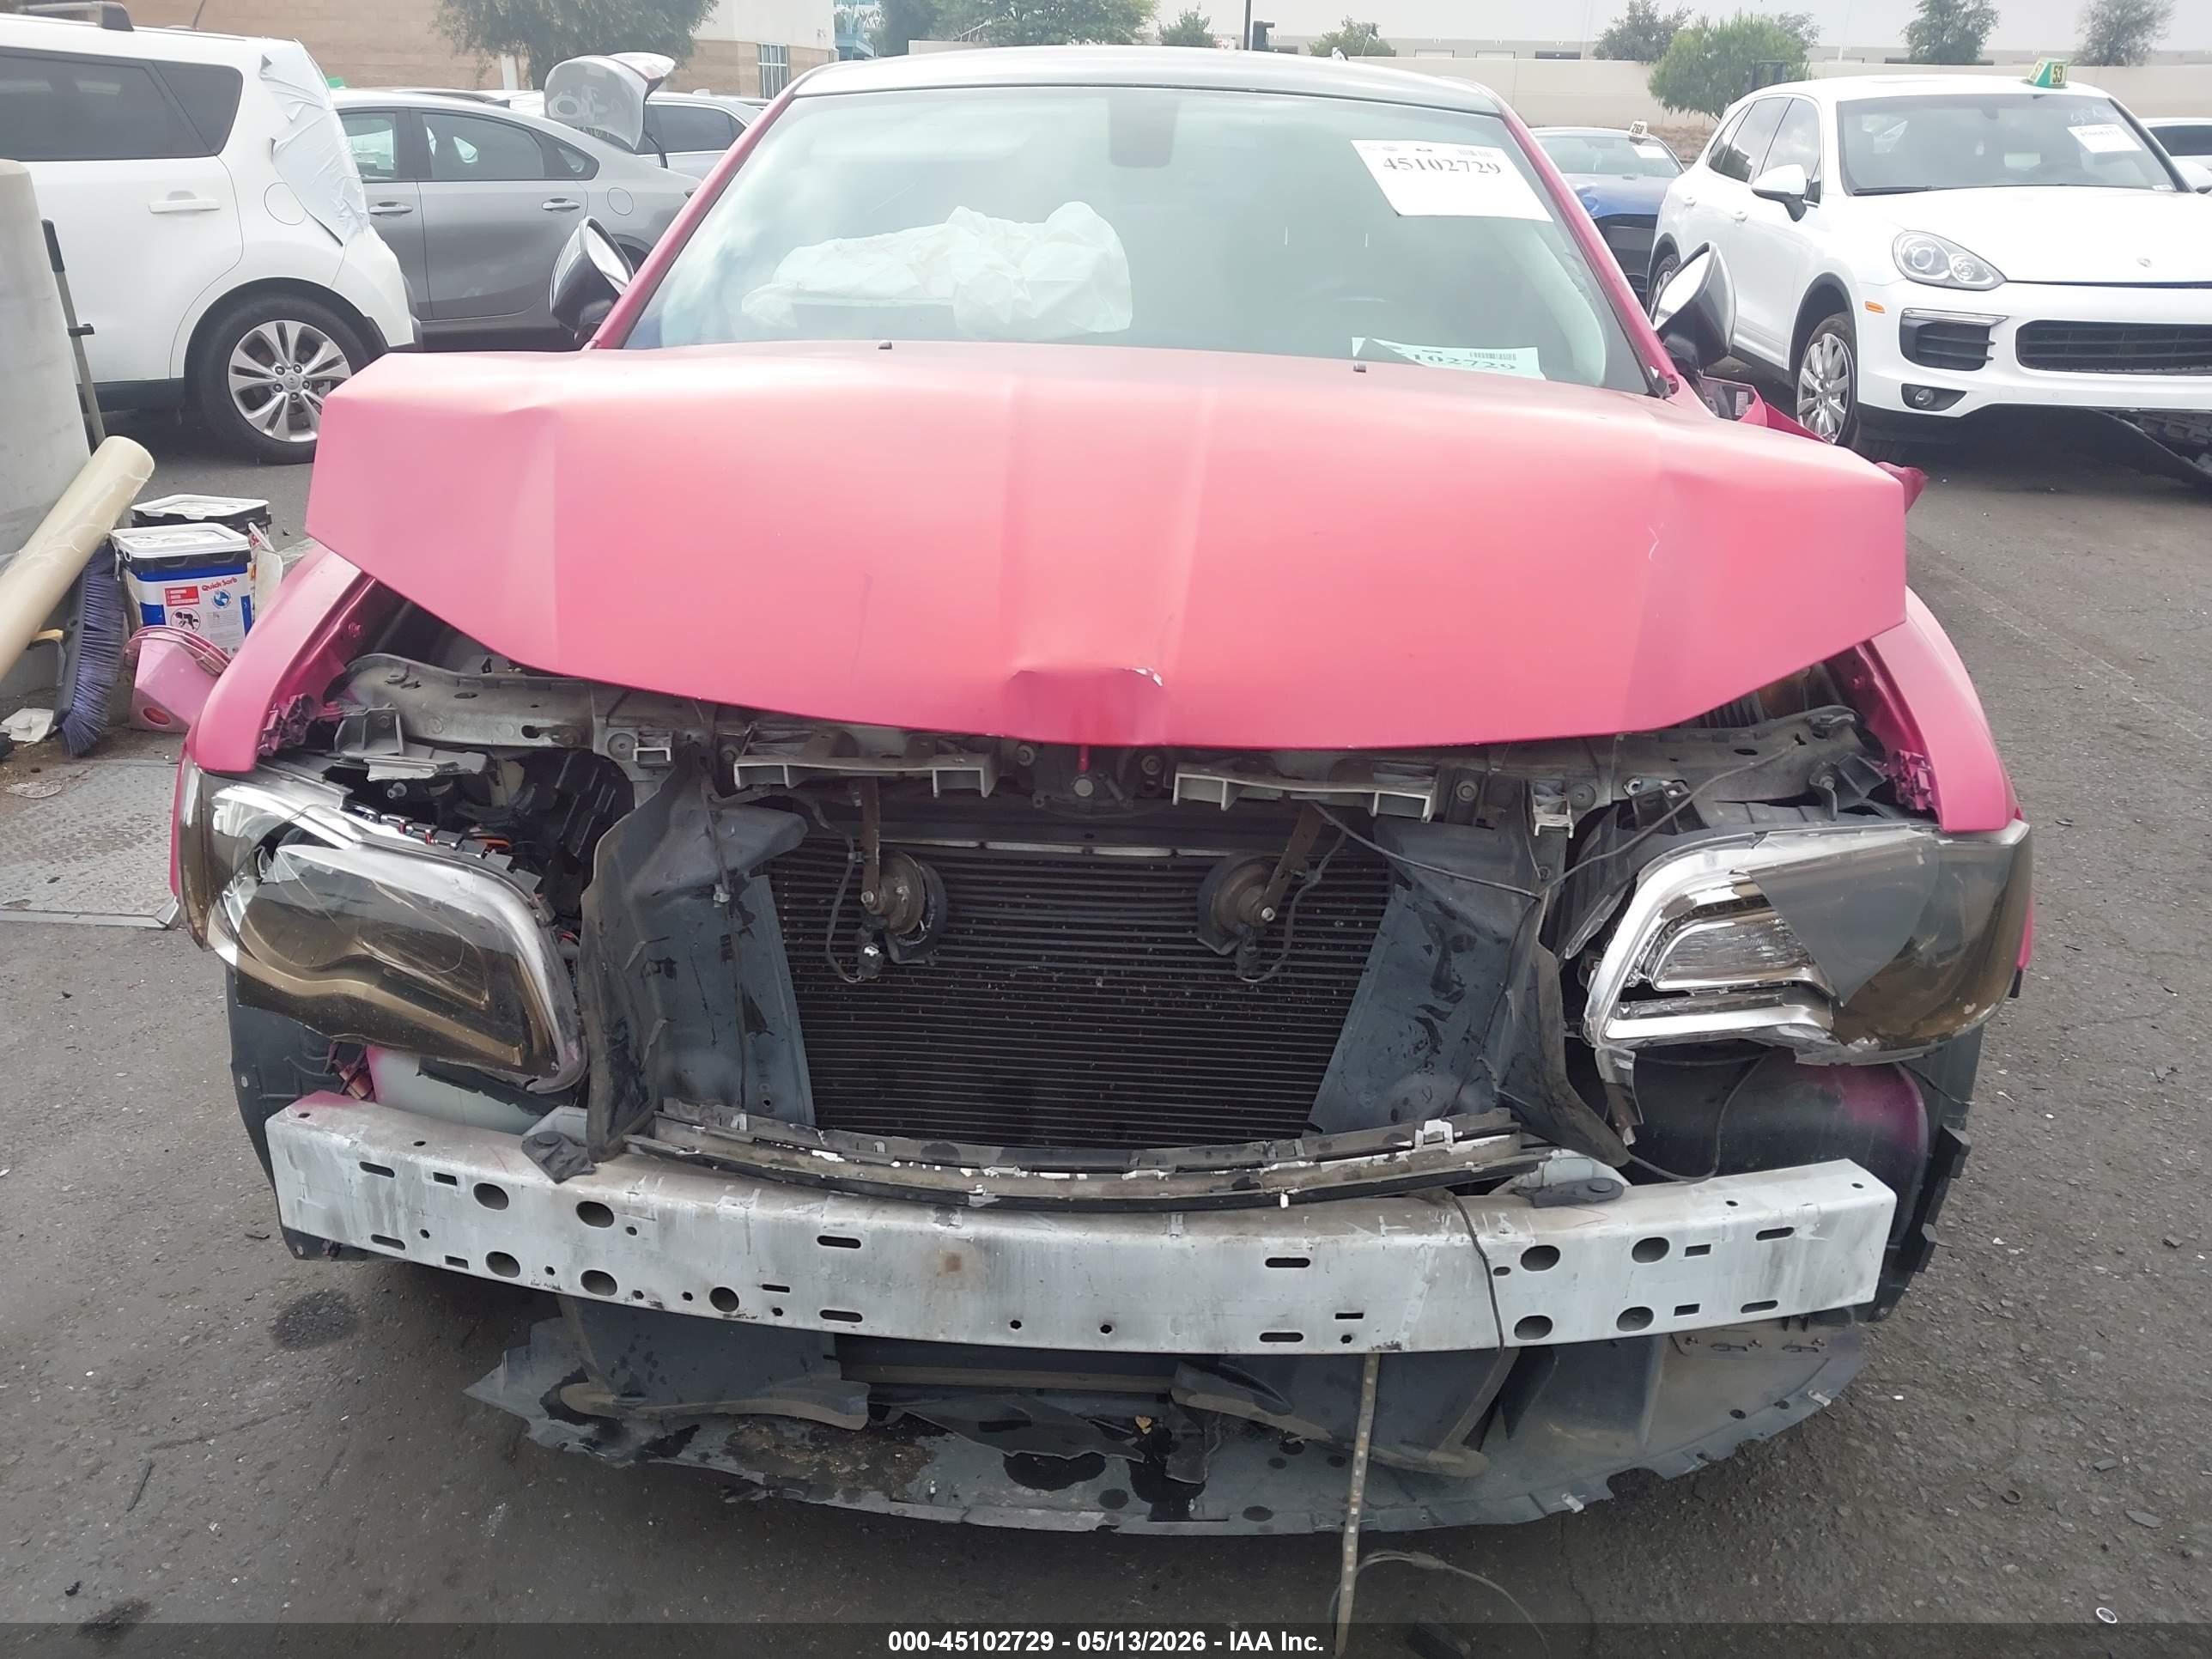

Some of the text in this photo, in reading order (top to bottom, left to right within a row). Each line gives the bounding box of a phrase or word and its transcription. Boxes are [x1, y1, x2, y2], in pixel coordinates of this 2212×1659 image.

[2052, 65, 2063, 83] 53
[1382, 156, 1502, 174] 45102729
[1413, 353, 1517, 370] 102729
[201, 581, 222, 592] Quick
